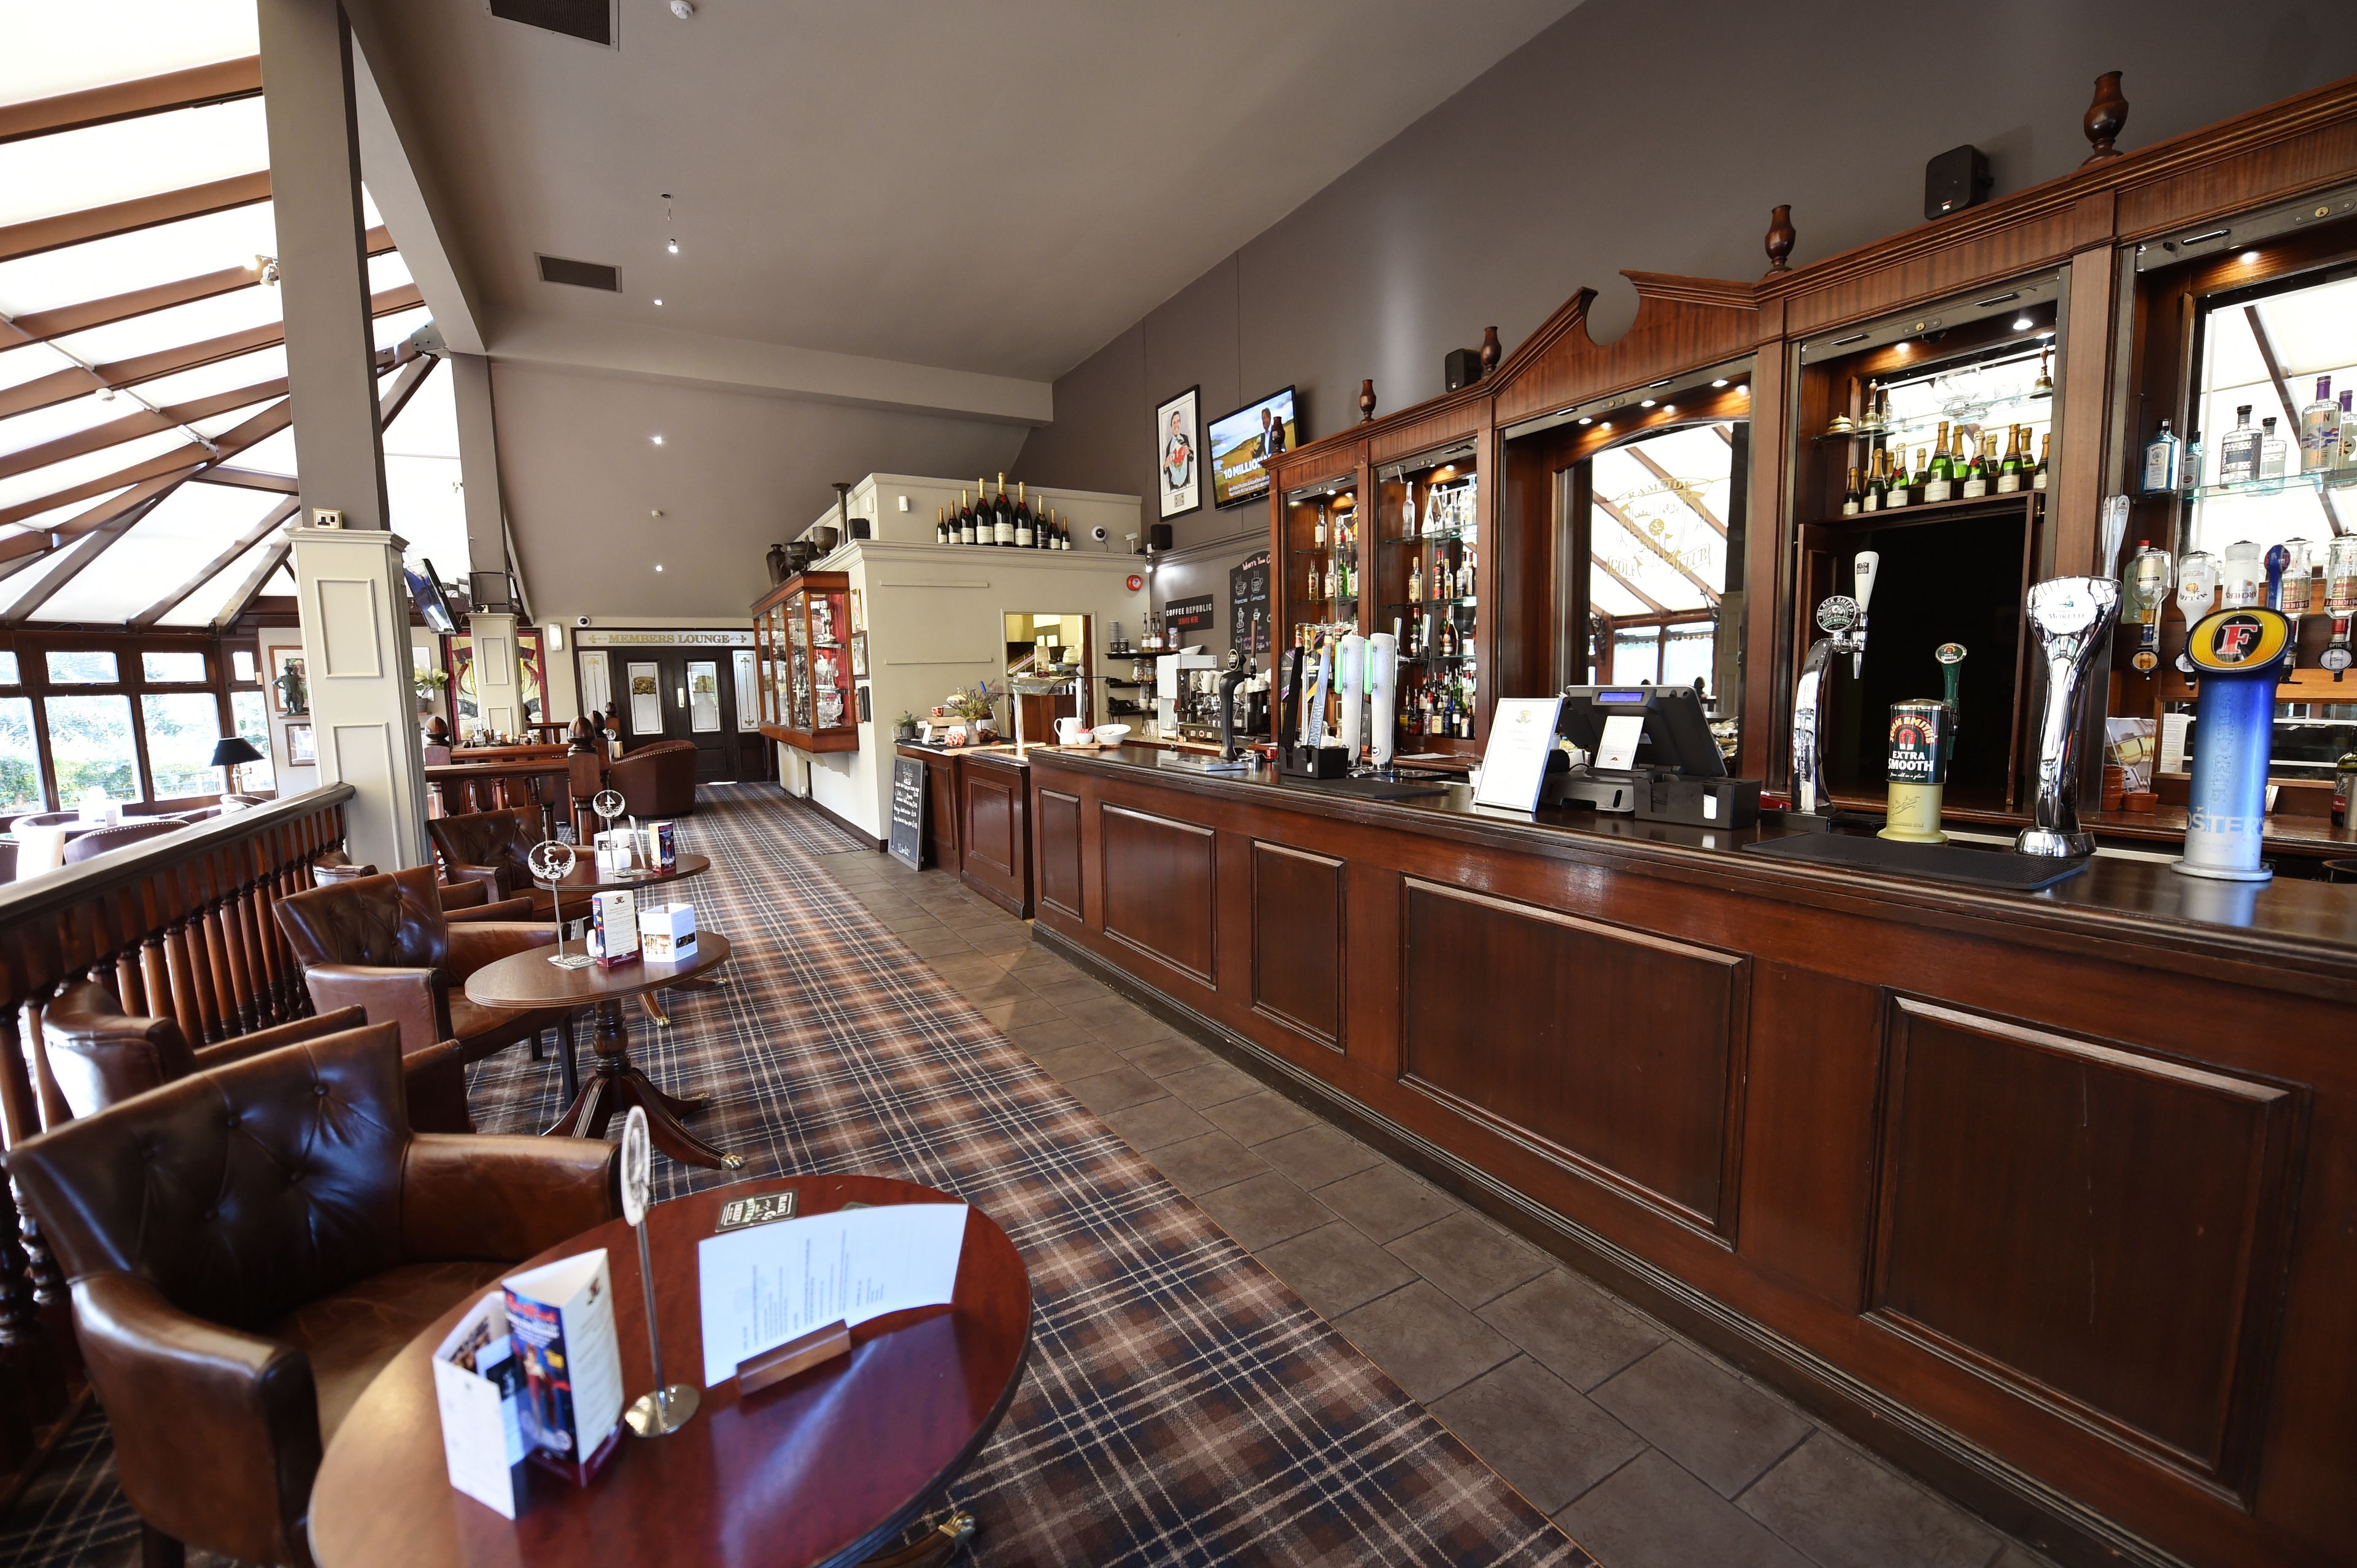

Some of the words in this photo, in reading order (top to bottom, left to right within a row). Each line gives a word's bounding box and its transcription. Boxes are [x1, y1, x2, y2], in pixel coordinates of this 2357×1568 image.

[1223, 468, 1233, 480] 10
[1166, 607, 1185, 617] COFFEE
[1185, 603, 1212, 614] REPUBLIC
[1817, 598, 1835, 617] BLACK
[1836, 597, 1854, 614] SHEEP
[608, 634, 675, 644] MEMBERS
[677, 634, 730, 644] LOUNGE
[2216, 624, 2258, 655] F
[1889, 717, 1903, 743] JOHN
[1892, 750, 1925, 760] EXTRA
[1887, 757, 1934, 773] SMOOTH
[741, 1197, 756, 1222] BITTER
[777, 1195, 788, 1214] BLACK
